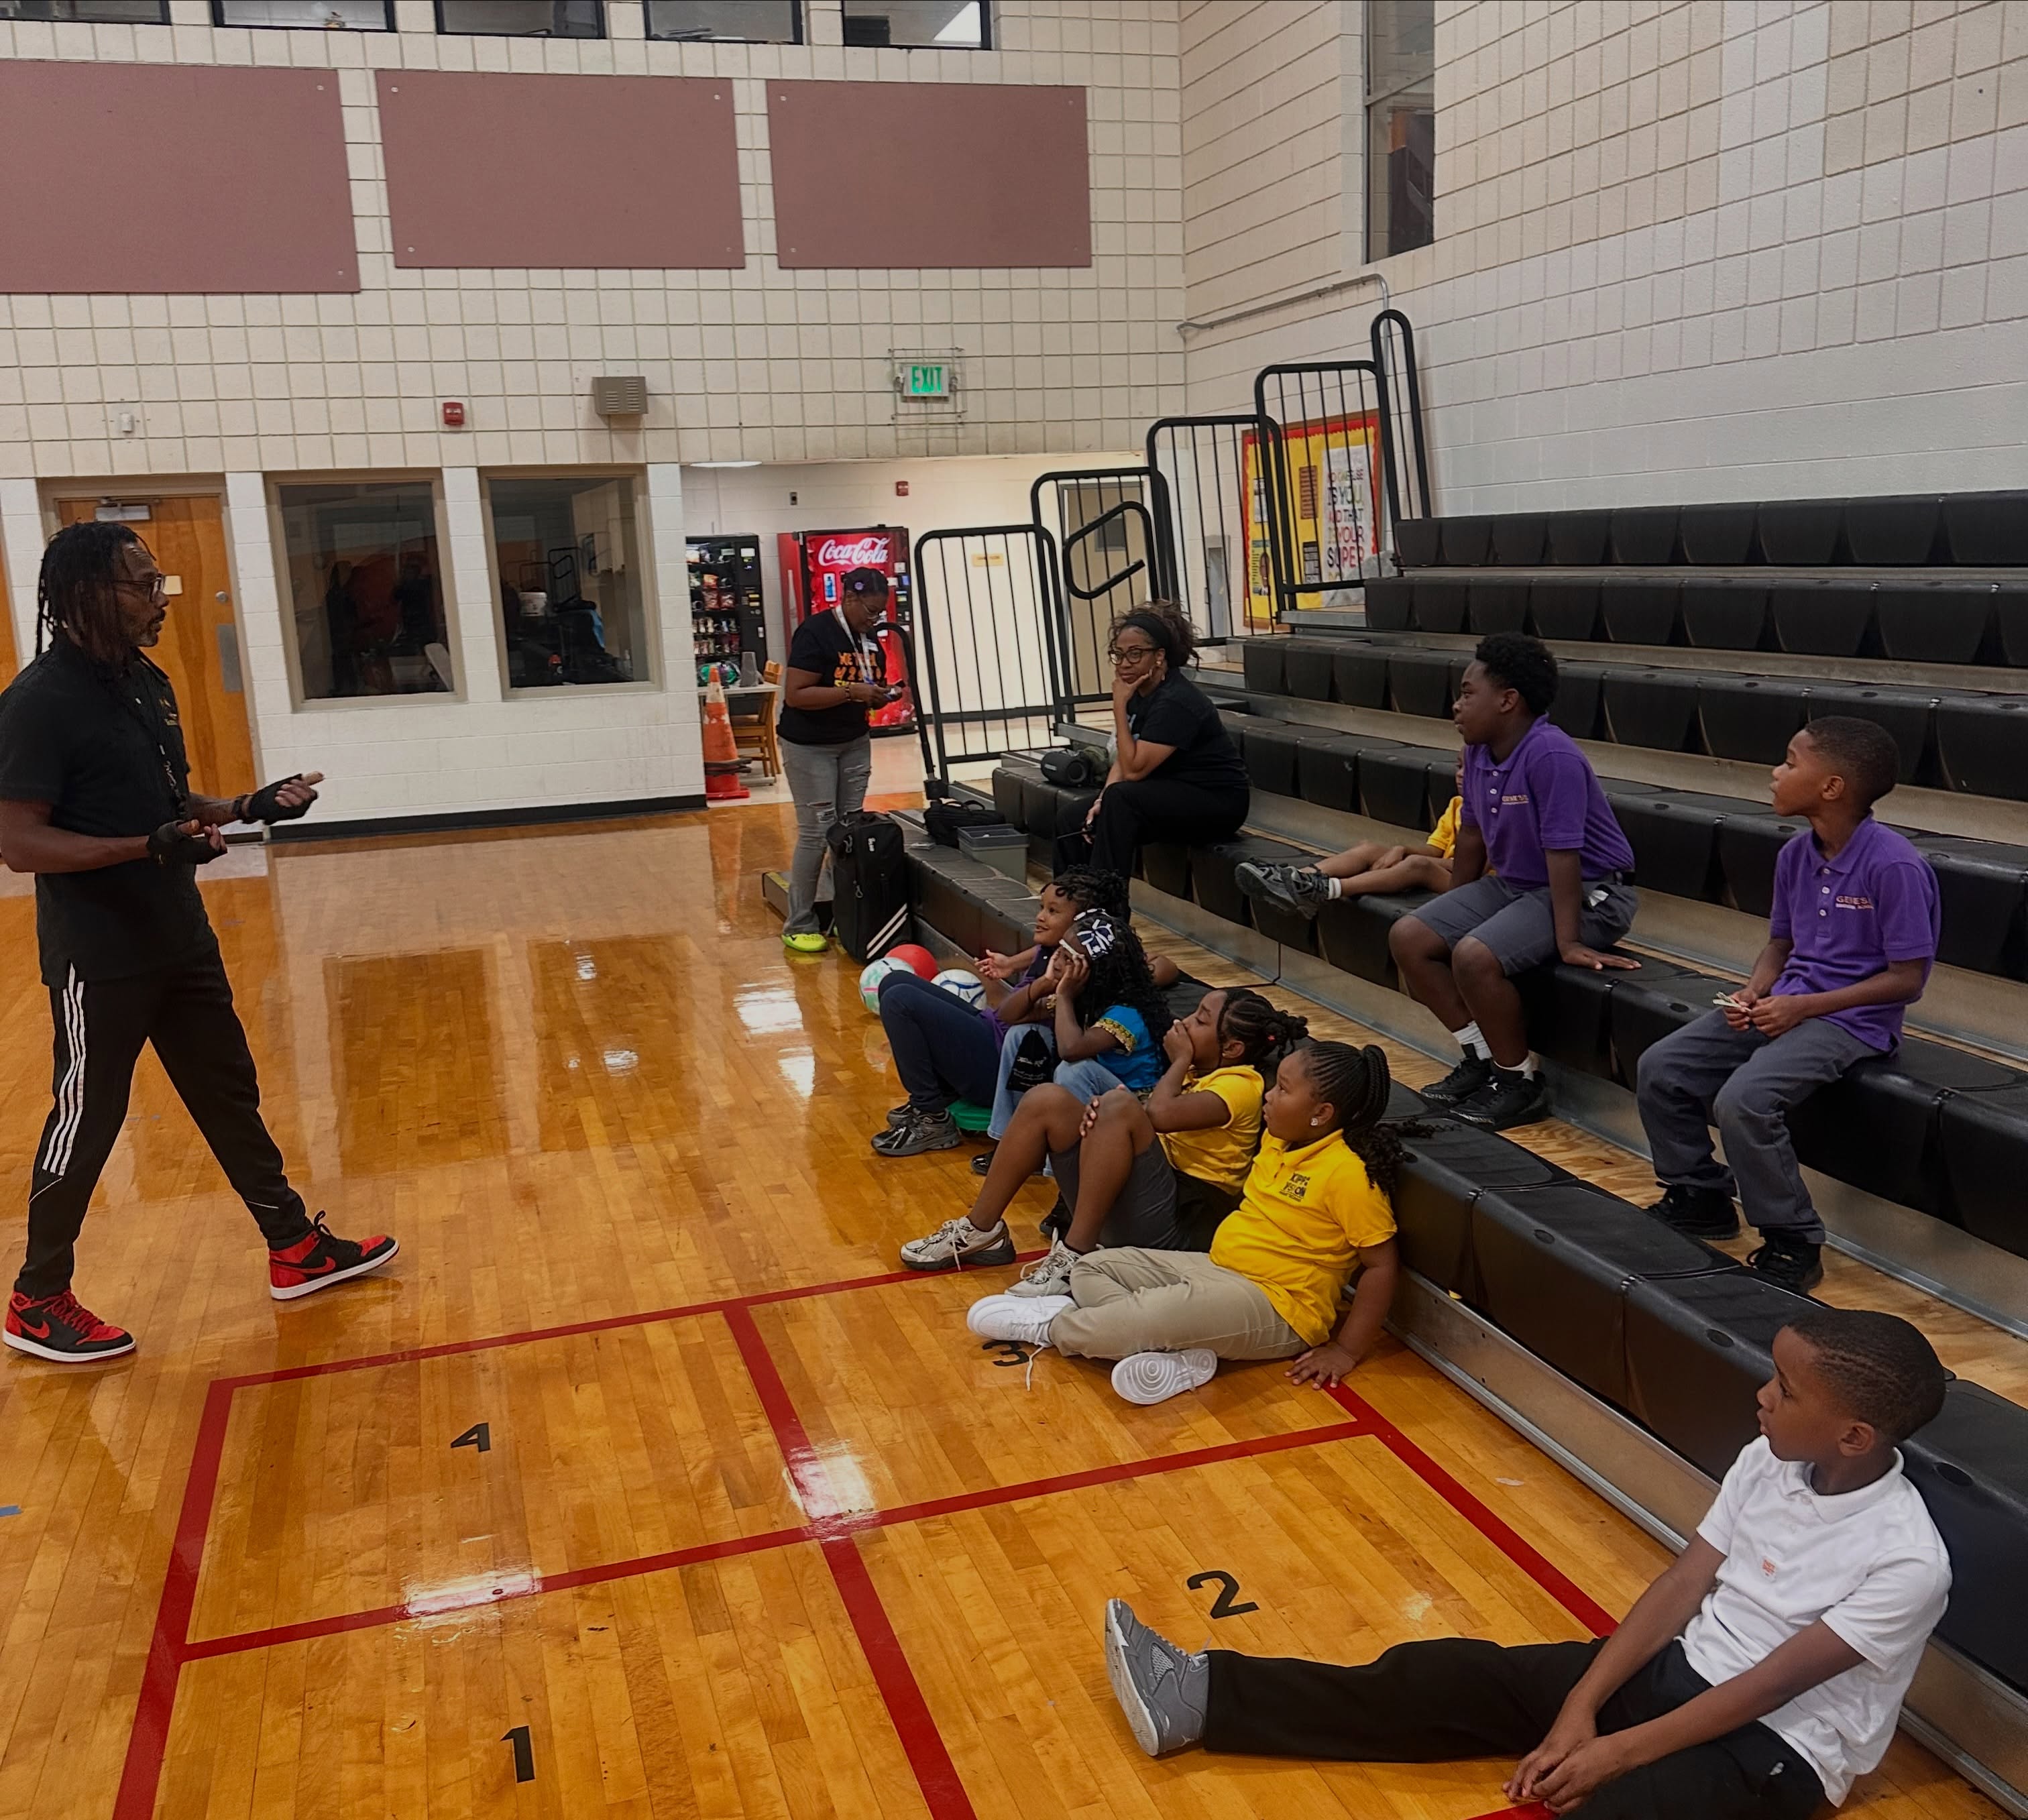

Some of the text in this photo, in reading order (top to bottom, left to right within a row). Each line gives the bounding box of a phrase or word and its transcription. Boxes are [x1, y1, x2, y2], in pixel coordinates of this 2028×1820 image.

[912, 366, 942, 393] EXIT
[818, 537, 891, 566] Coca-Cola
[982, 1341, 1029, 1367] 3
[451, 1422, 491, 1453] 4
[1187, 1571, 1260, 1619] 2
[500, 1725, 535, 1783] 1
